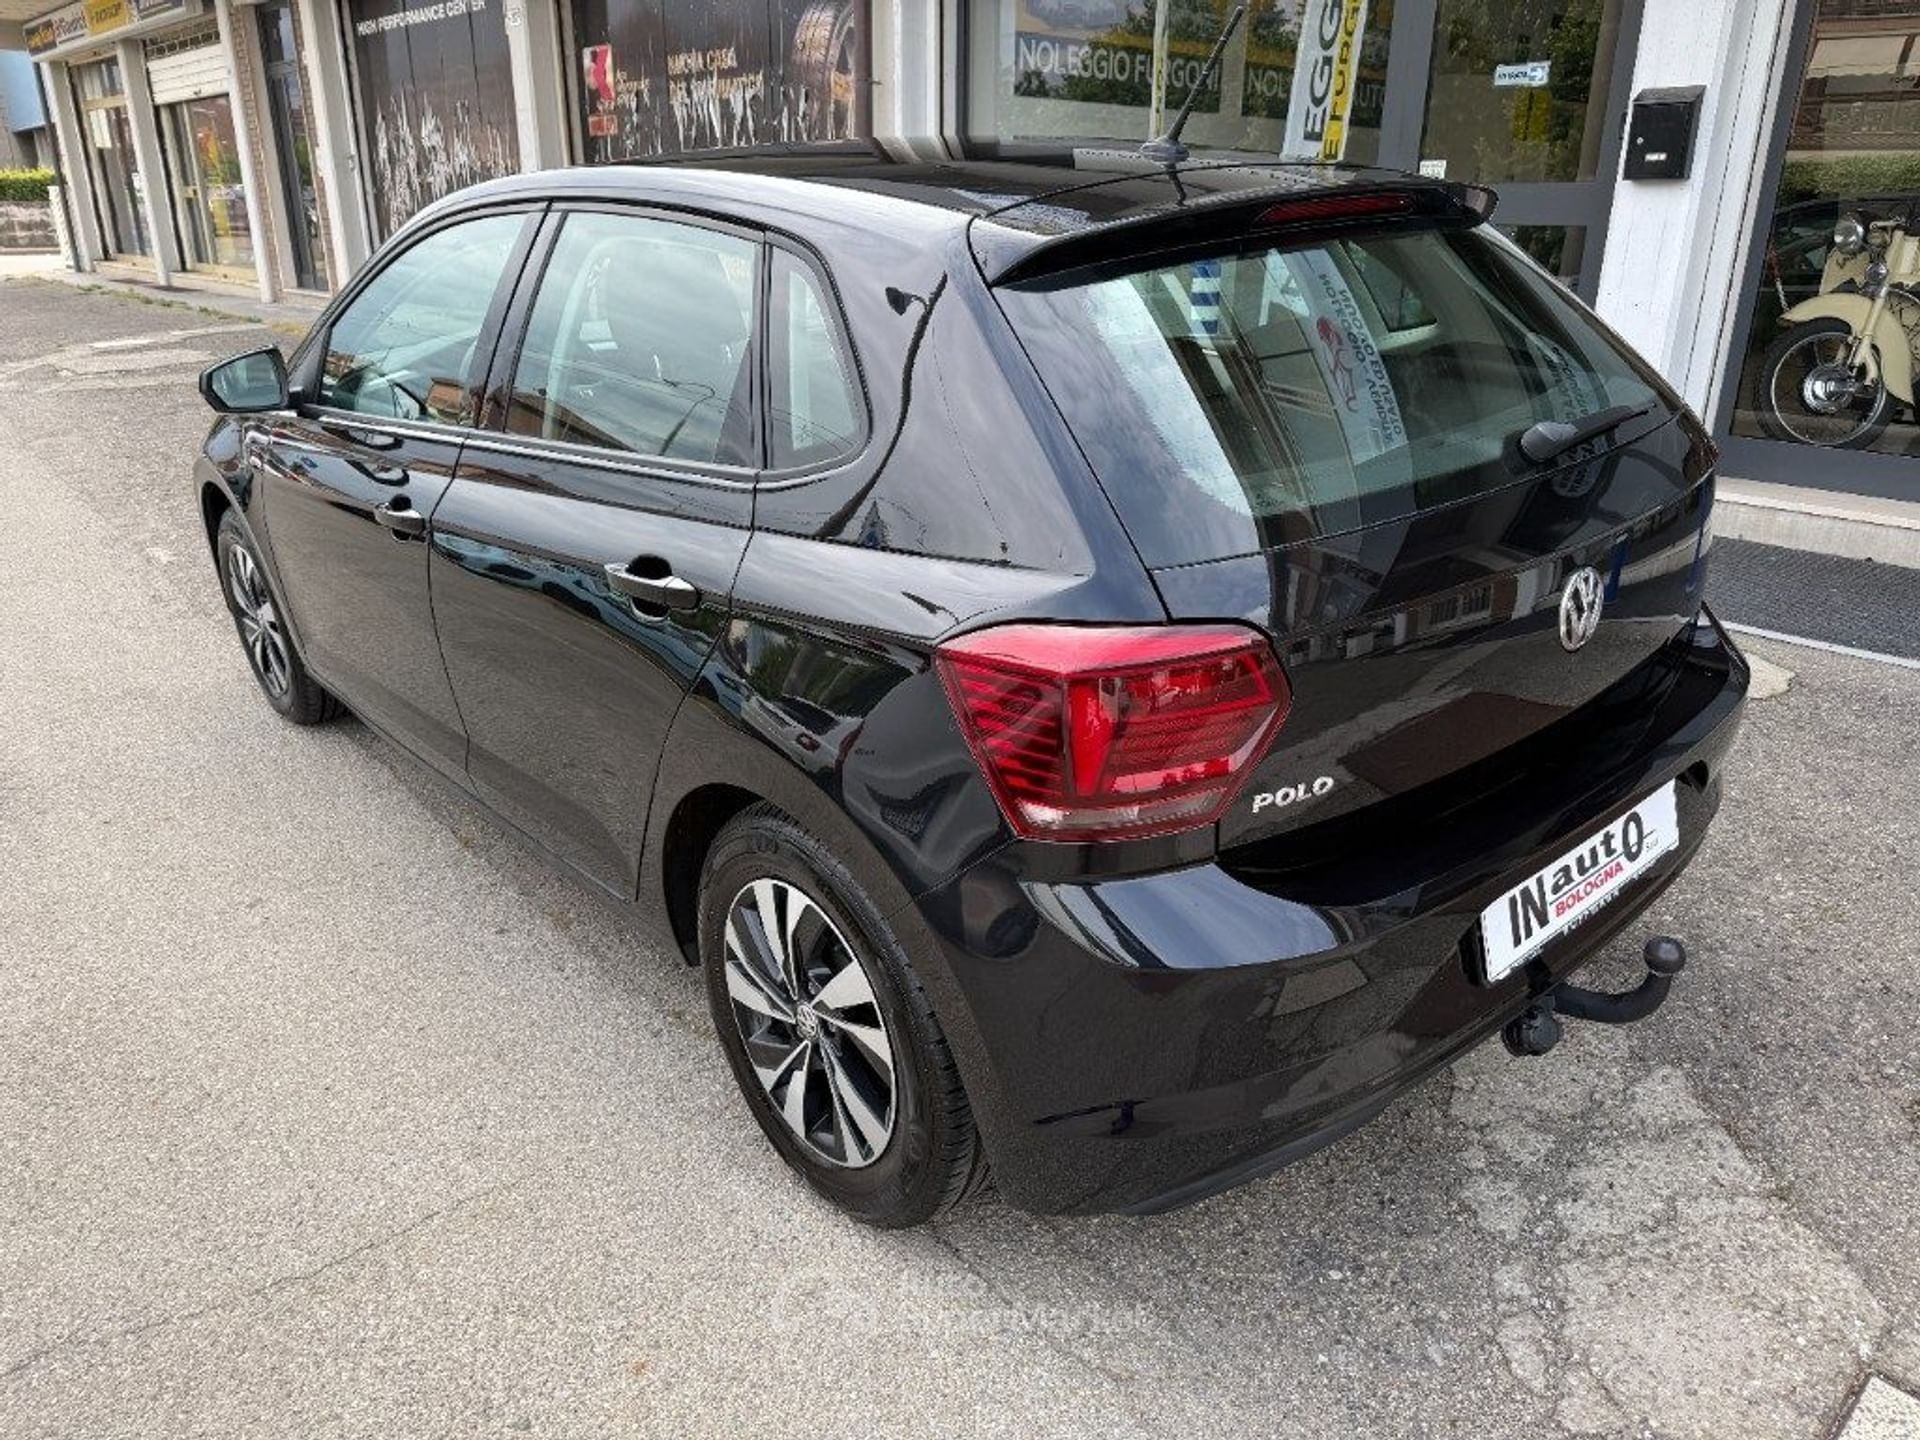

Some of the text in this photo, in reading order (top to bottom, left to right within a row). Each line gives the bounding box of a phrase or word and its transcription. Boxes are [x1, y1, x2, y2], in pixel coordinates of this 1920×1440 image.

[356, 20, 379, 37] HIGH
[378, 3, 446, 32] PERFORMANCE
[1019, 37, 1130, 82] NOLEGGIO
[1251, 775, 1334, 813] POLO
[1554, 860, 1625, 918] BOLOGNA
